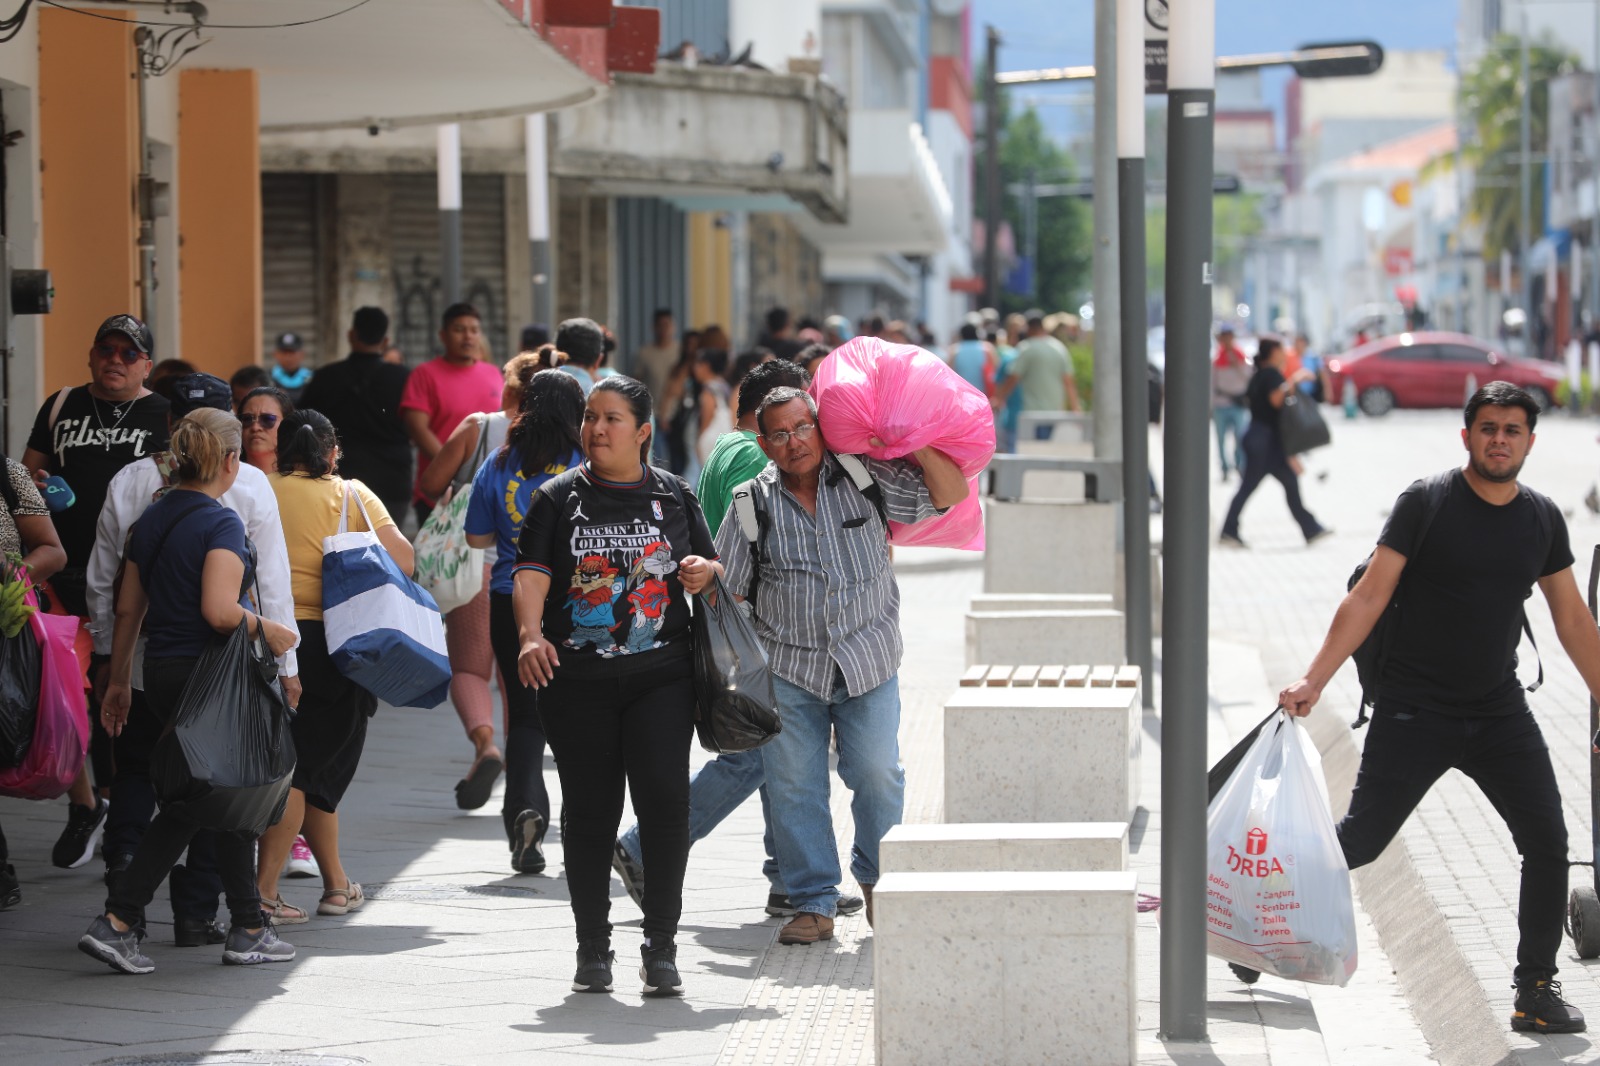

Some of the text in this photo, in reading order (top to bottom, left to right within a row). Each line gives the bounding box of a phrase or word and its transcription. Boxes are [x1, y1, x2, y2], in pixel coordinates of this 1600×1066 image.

[54, 415, 152, 467] Gibson
[505, 480, 523, 524] BORN
[583, 524, 647, 536] KICKIN' IT
[579, 538, 606, 549] OLD
[1226, 845, 1284, 878] TORBA
[1208, 873, 1229, 889] Bolso
[1206, 902, 1233, 918] ochila
[1206, 915, 1233, 930] etera
[1261, 929, 1291, 937] Joyero
